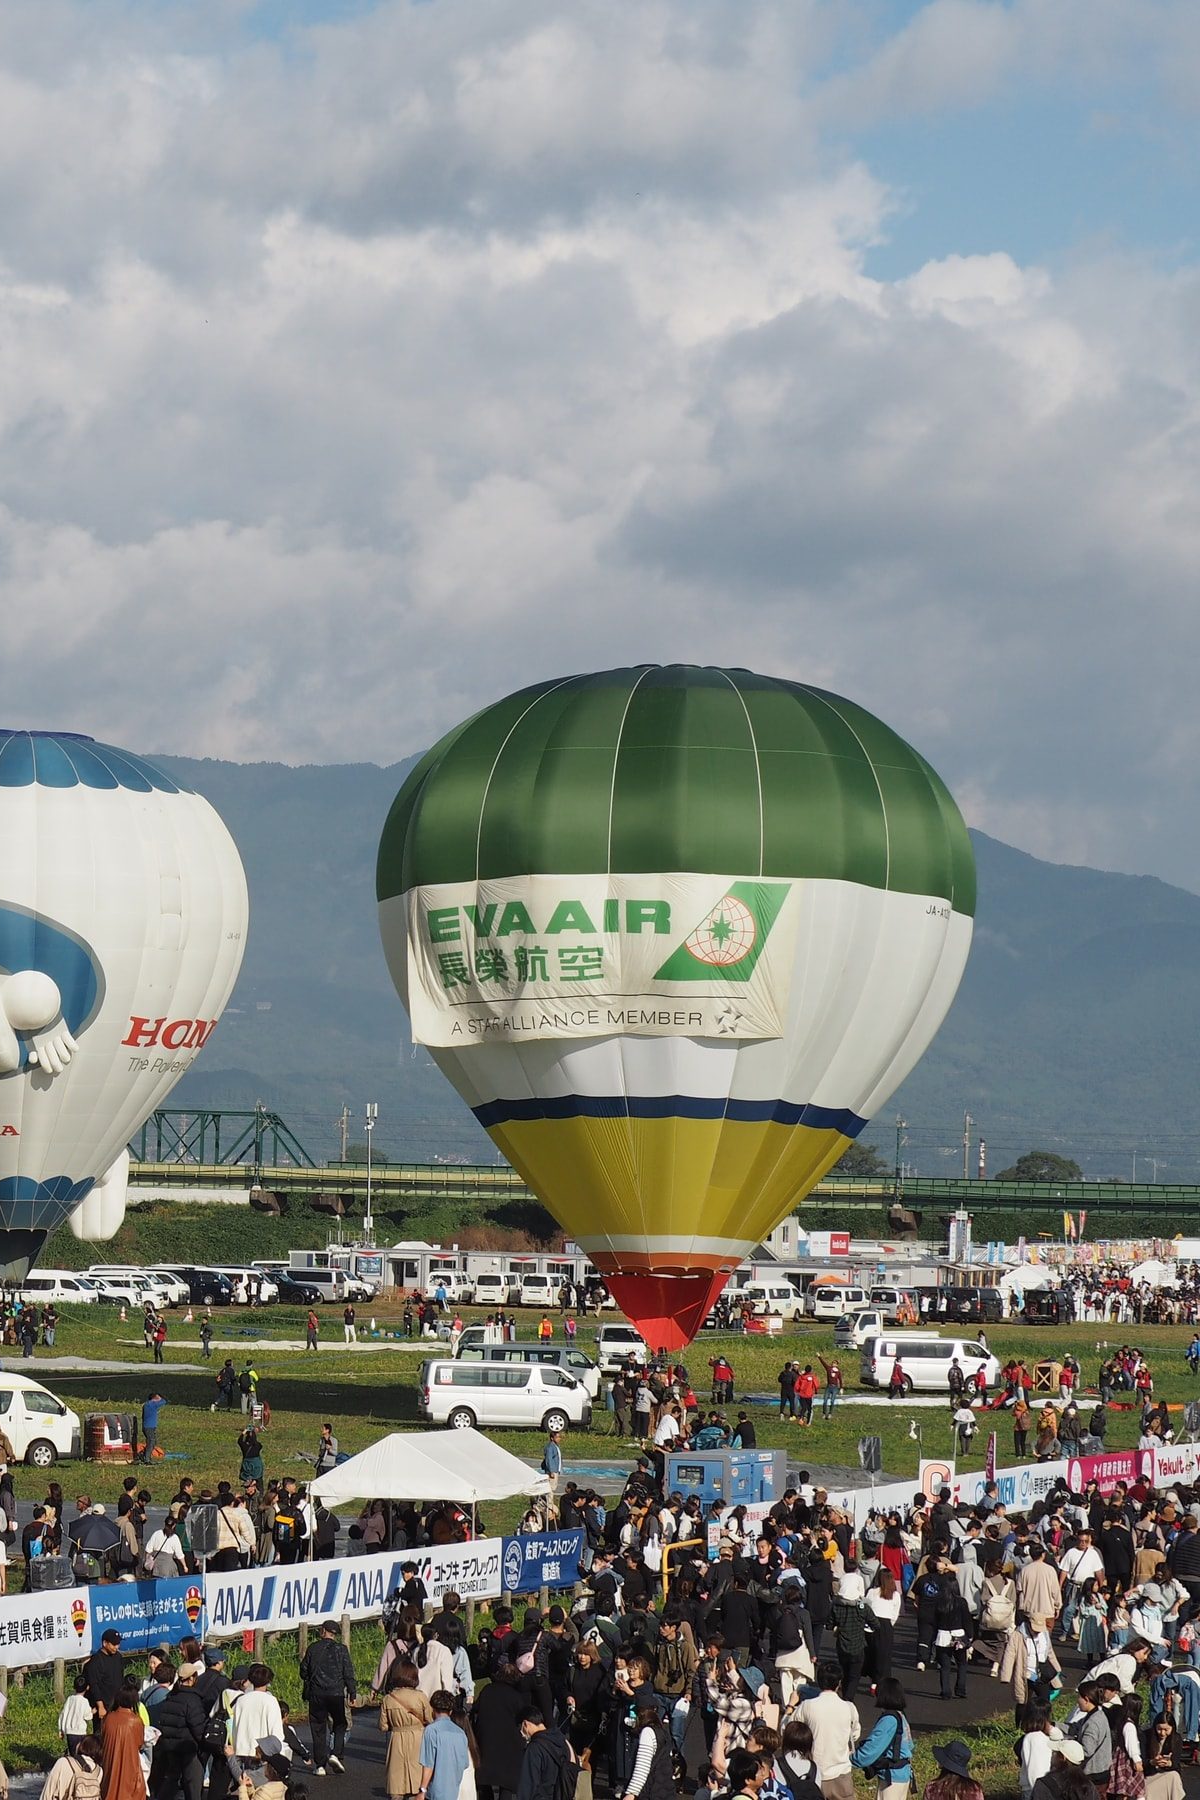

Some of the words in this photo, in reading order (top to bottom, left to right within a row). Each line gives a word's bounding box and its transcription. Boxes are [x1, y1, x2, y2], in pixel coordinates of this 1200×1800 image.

[437, 945, 605, 989] 長榮航空
[451, 1021, 463, 1035] A
[502, 1010, 600, 1032] ALLIANCE
[607, 1010, 703, 1026] MEMBER
[1158, 1456, 1184, 1477] Yakult
[343, 1568, 385, 1610] ANA
[434, 1561, 460, 1582] コトブキ
[462, 1554, 499, 1578] テクレックス
[213, 1584, 254, 1626] ANA
[278, 1577, 320, 1619] ANA
